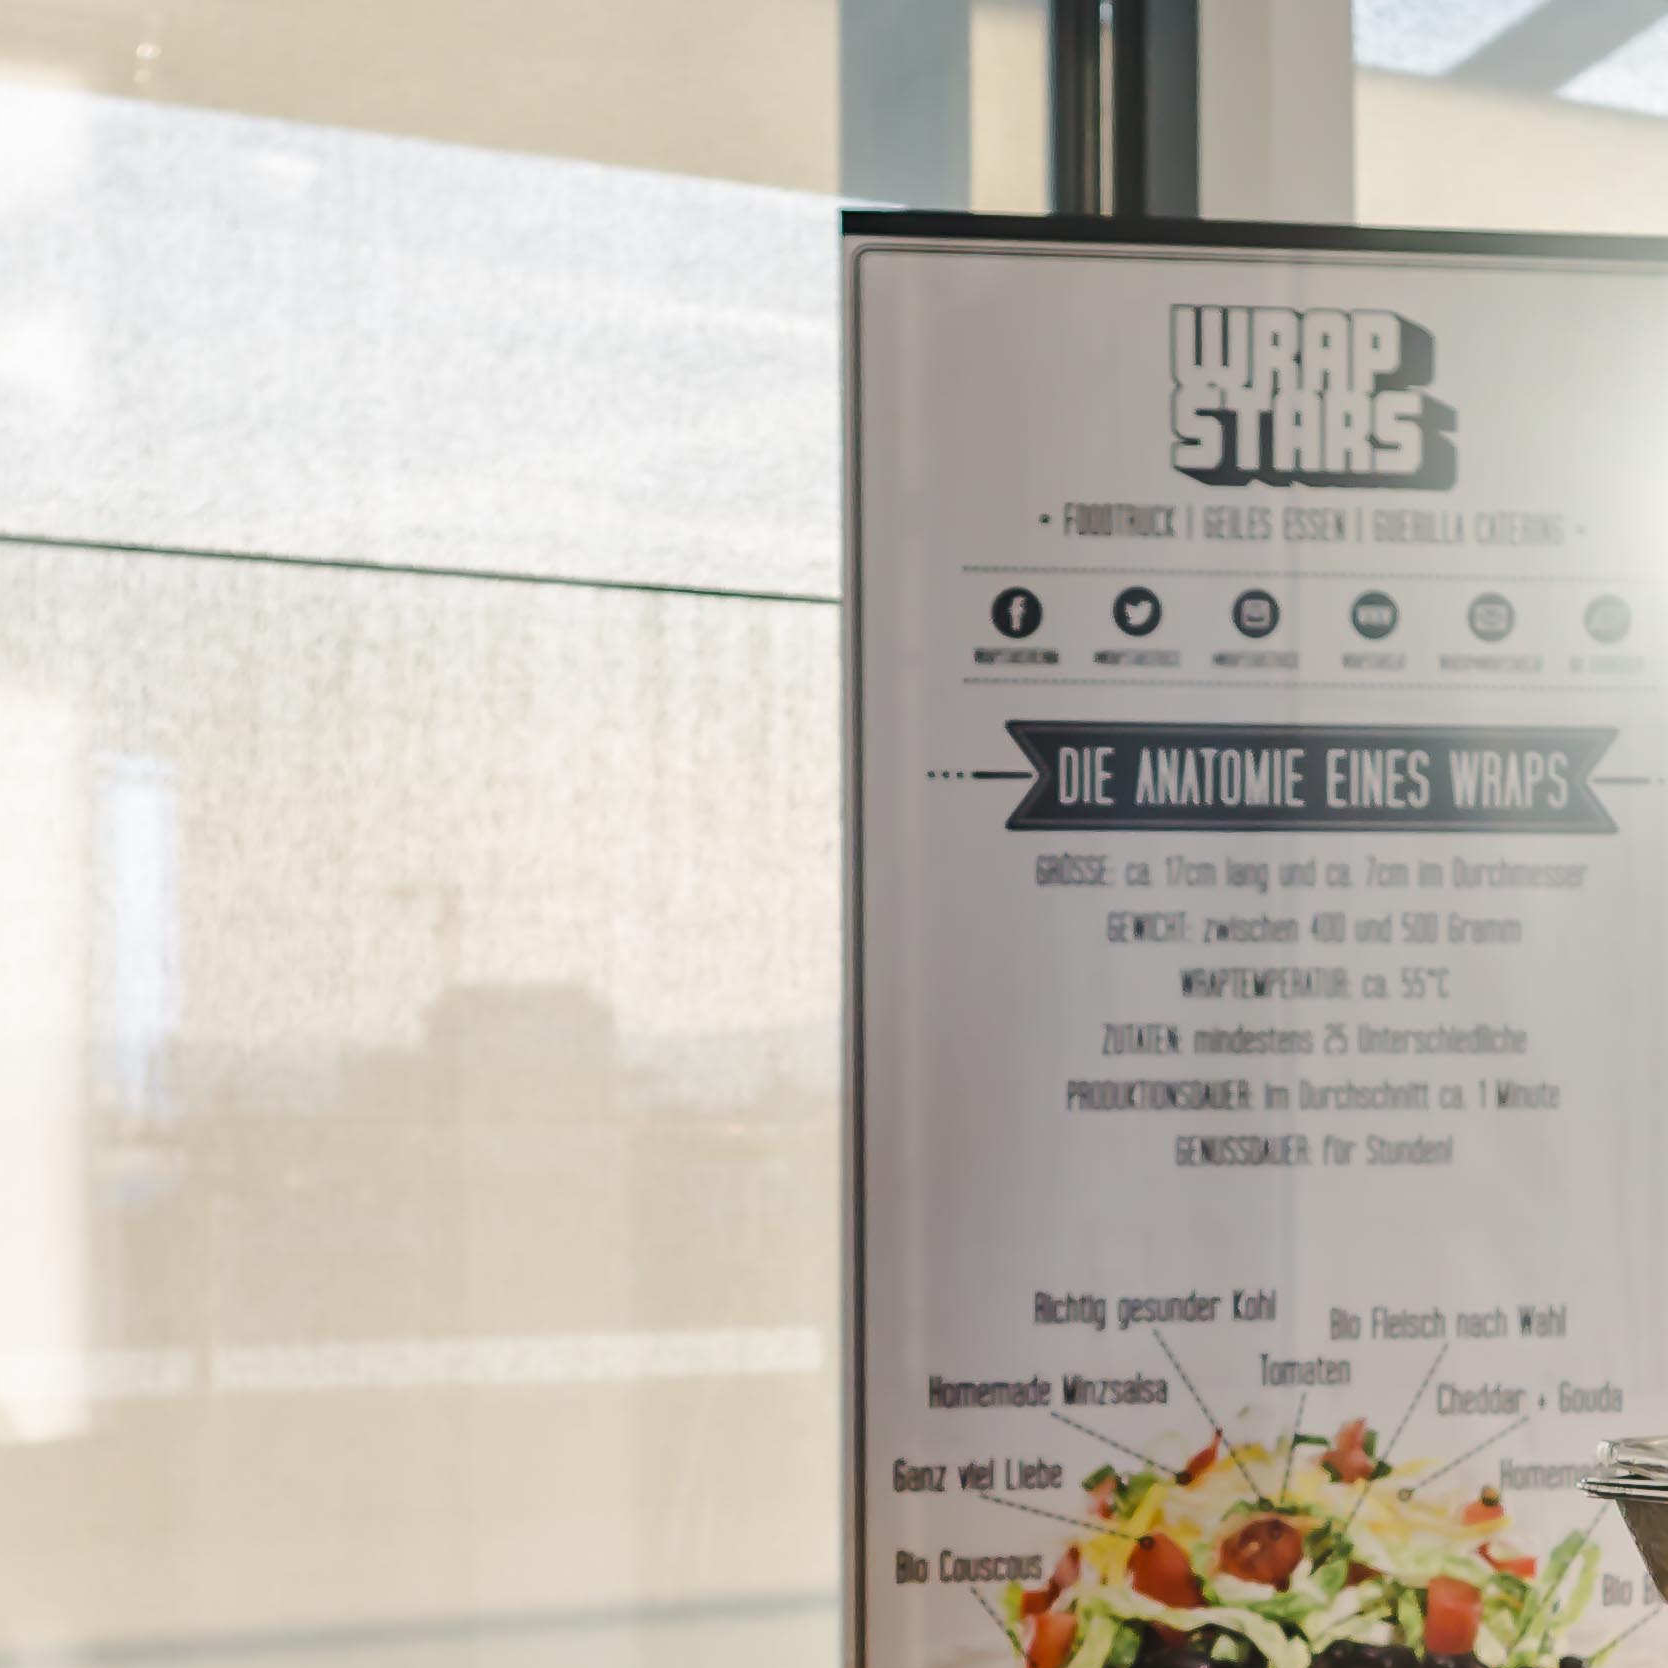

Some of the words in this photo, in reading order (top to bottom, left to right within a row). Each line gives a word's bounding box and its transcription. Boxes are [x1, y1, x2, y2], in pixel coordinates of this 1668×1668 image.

[1170, 303, 1435, 392] WRAP
[1170, 388, 1458, 488] STARS
[1062, 502, 1175, 537] FOODTRUCK
[1203, 504, 1272, 540] GEILES
[1283, 506, 1346, 542] ESSEN
[1058, 746, 1116, 806] DIE
[1136, 748, 1307, 808] ANATOMIE
[1325, 748, 1431, 809] EINES
[1448, 749, 1569, 809] WRAPS
[1225, 855, 1269, 896] lang
[1279, 857, 1317, 888] und
[1364, 856, 1409, 888] 7cm
[1450, 856, 1589, 889] Durchmesser
[1203, 912, 1299, 944] zwischen
[1354, 913, 1392, 943] und
[1447, 911, 1522, 944] Gramm
[1194, 1024, 1315, 1055] mindestens
[1299, 1079, 1429, 1111] Durchschnitt
[1496, 1079, 1561, 1110] Minute
[1035, 1290, 1106, 1331] Richtig
[1118, 1291, 1220, 1330] gesunder
[1233, 1288, 1276, 1321] Kohl
[1330, 1307, 1360, 1341] Bio
[1371, 1305, 1446, 1341] Fleisch
[1457, 1306, 1508, 1339] nach
[1518, 1305, 1567, 1338] Wahl
[1260, 1352, 1351, 1386] Tomaten
[929, 1375, 1052, 1408] Homemade
[1437, 1381, 1526, 1416] Cheddar
[1558, 1379, 1623, 1413] Gouda
[893, 1457, 947, 1492] Ganz
[958, 1456, 995, 1490] viel
[1006, 1456, 1063, 1490] Liebe
[896, 1549, 928, 1584] Bio
[940, 1549, 1042, 1583] Couscous
[1602, 1572, 1633, 1606] Bio
